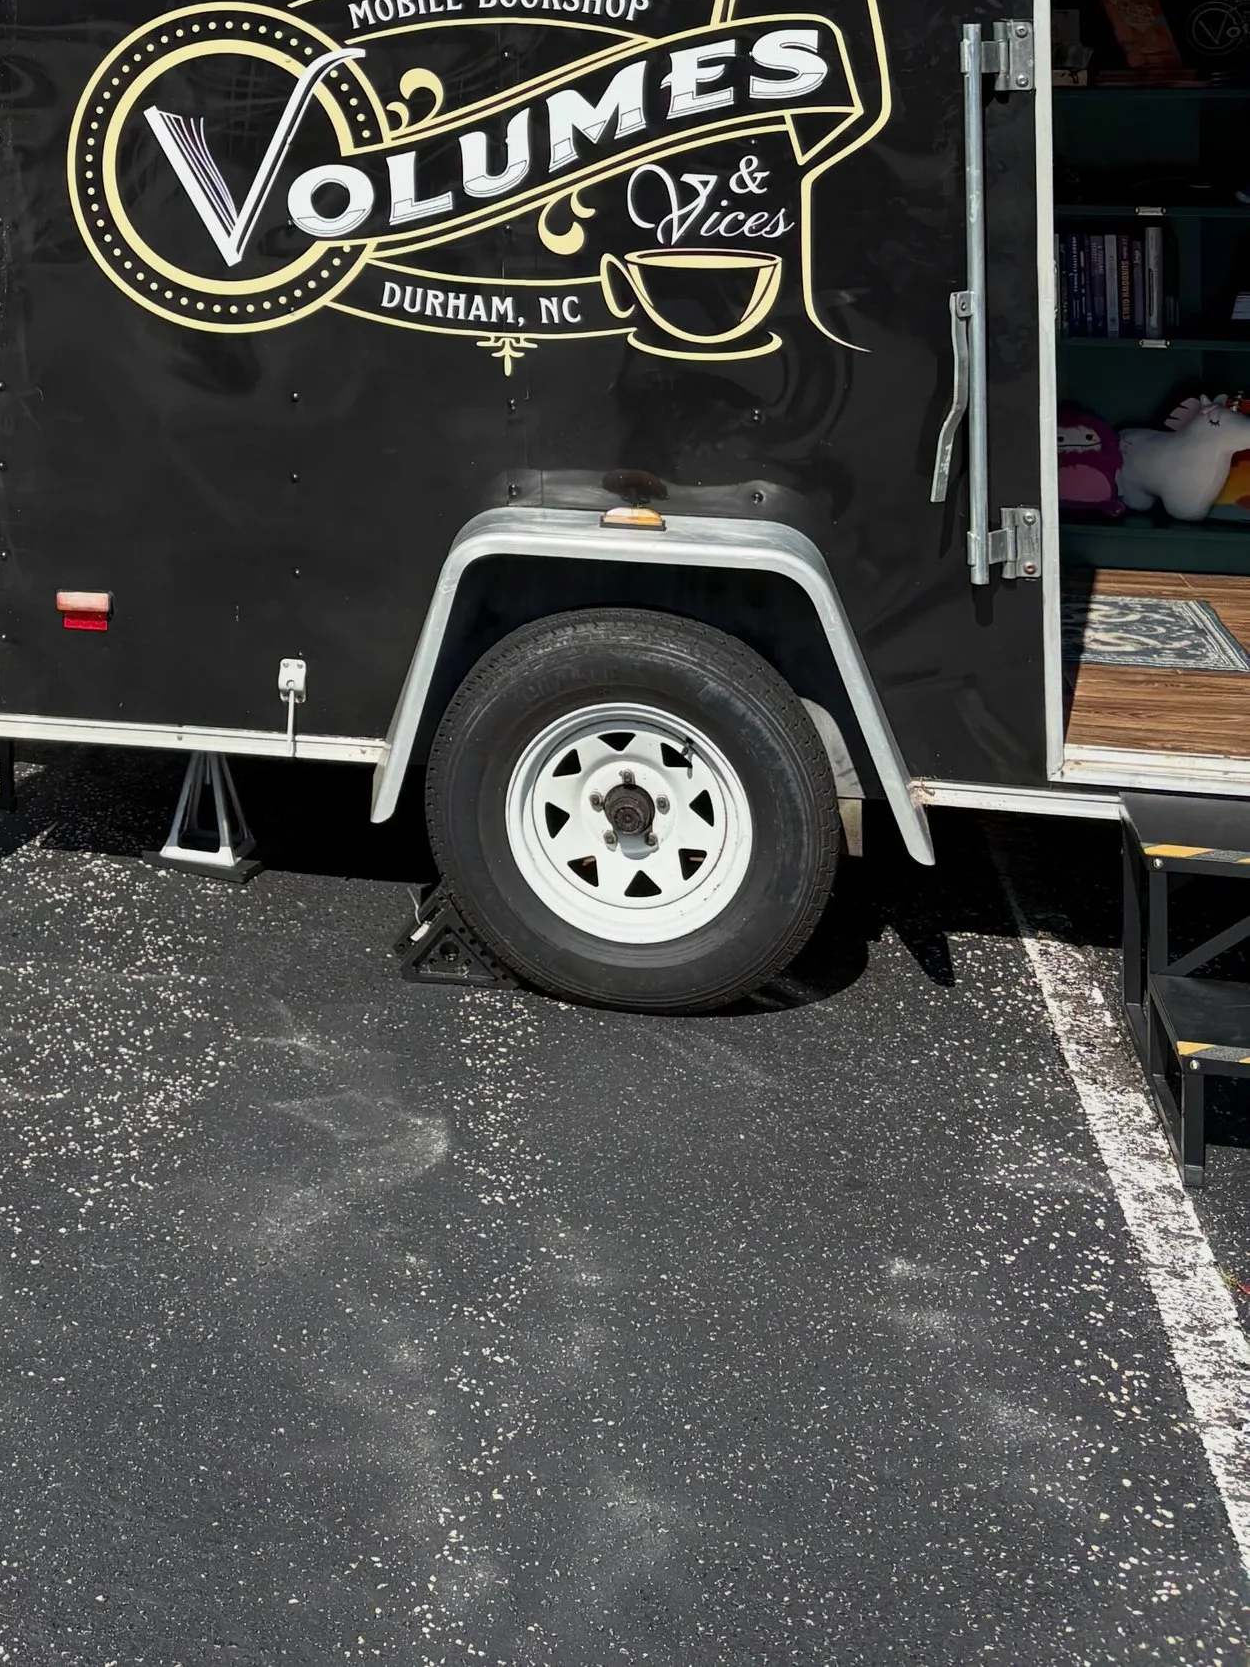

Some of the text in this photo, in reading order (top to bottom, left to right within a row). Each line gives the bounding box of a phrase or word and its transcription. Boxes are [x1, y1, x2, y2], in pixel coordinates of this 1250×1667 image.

[143, 29, 829, 268] VOLUMES
[728, 154, 771, 195] &
[626, 163, 796, 247] Vices
[380, 280, 583, 327] DURHAM, NC
